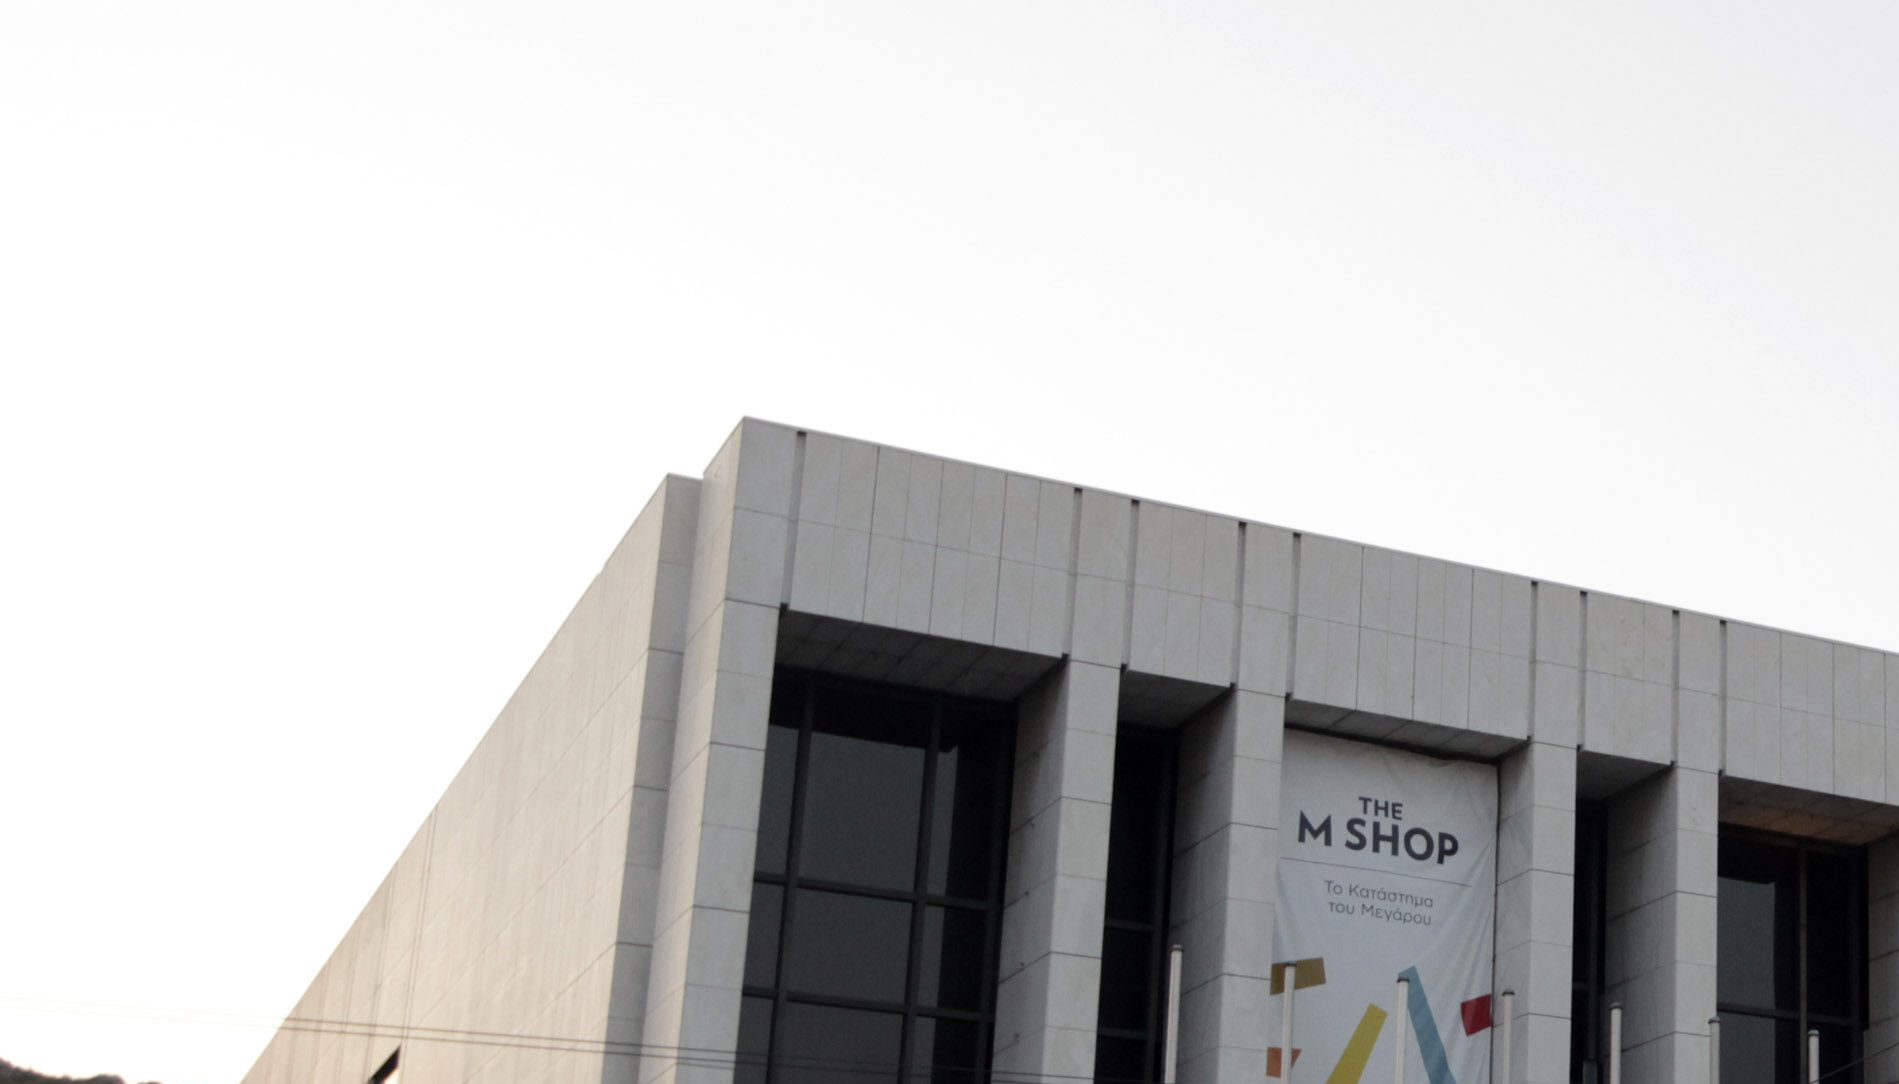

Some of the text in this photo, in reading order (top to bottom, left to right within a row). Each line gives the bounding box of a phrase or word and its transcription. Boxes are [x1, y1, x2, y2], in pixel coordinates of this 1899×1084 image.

[1358, 796, 1403, 821] THE
[1298, 809, 1459, 865] M SHOP
[1324, 879, 1434, 908] Το Κατάστημα
[1328, 901, 1432, 926] του Μεγάρου
